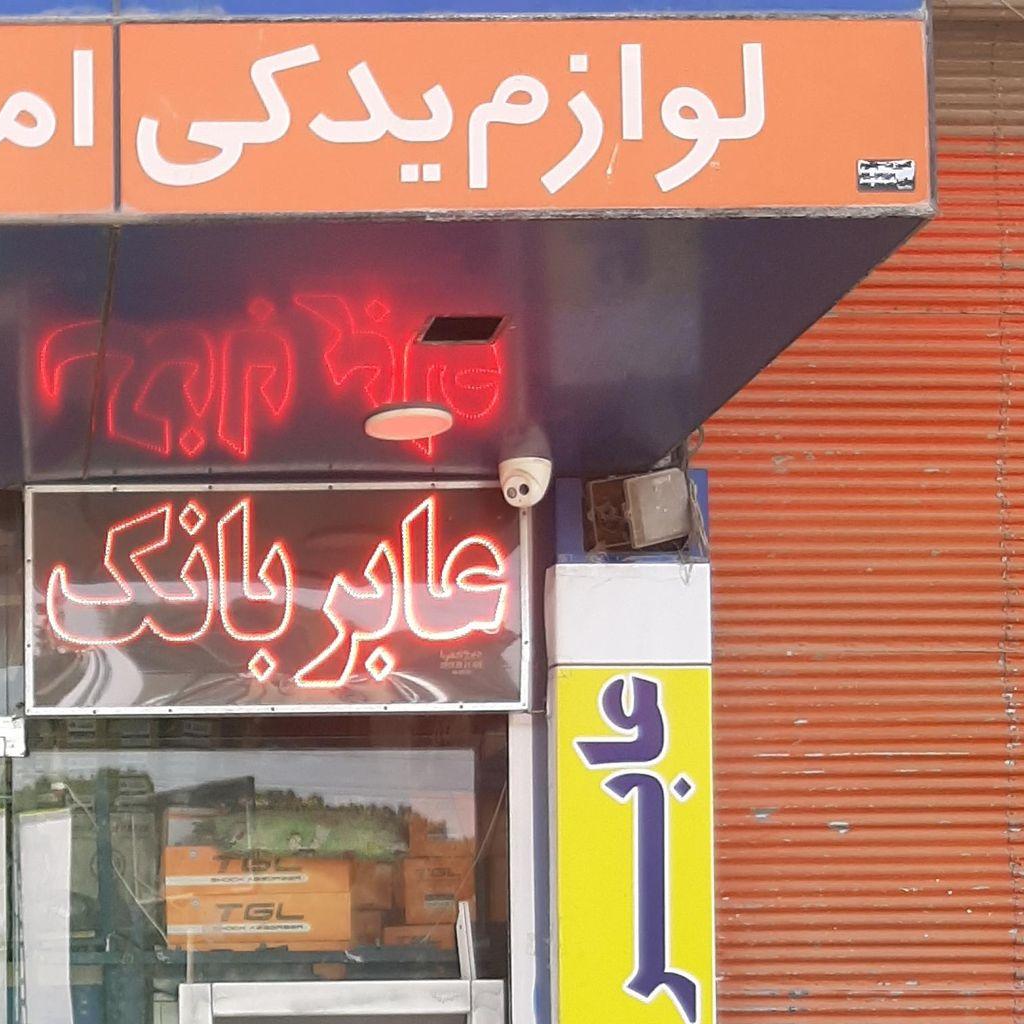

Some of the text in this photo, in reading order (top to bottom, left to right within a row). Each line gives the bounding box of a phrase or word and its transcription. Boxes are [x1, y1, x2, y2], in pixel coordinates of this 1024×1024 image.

[135, 44, 454, 186] یدکی
[468, 43, 766, 193] لوازم
[47, 496, 507, 688] عابر بانک
[216, 902, 305, 922] TGL
